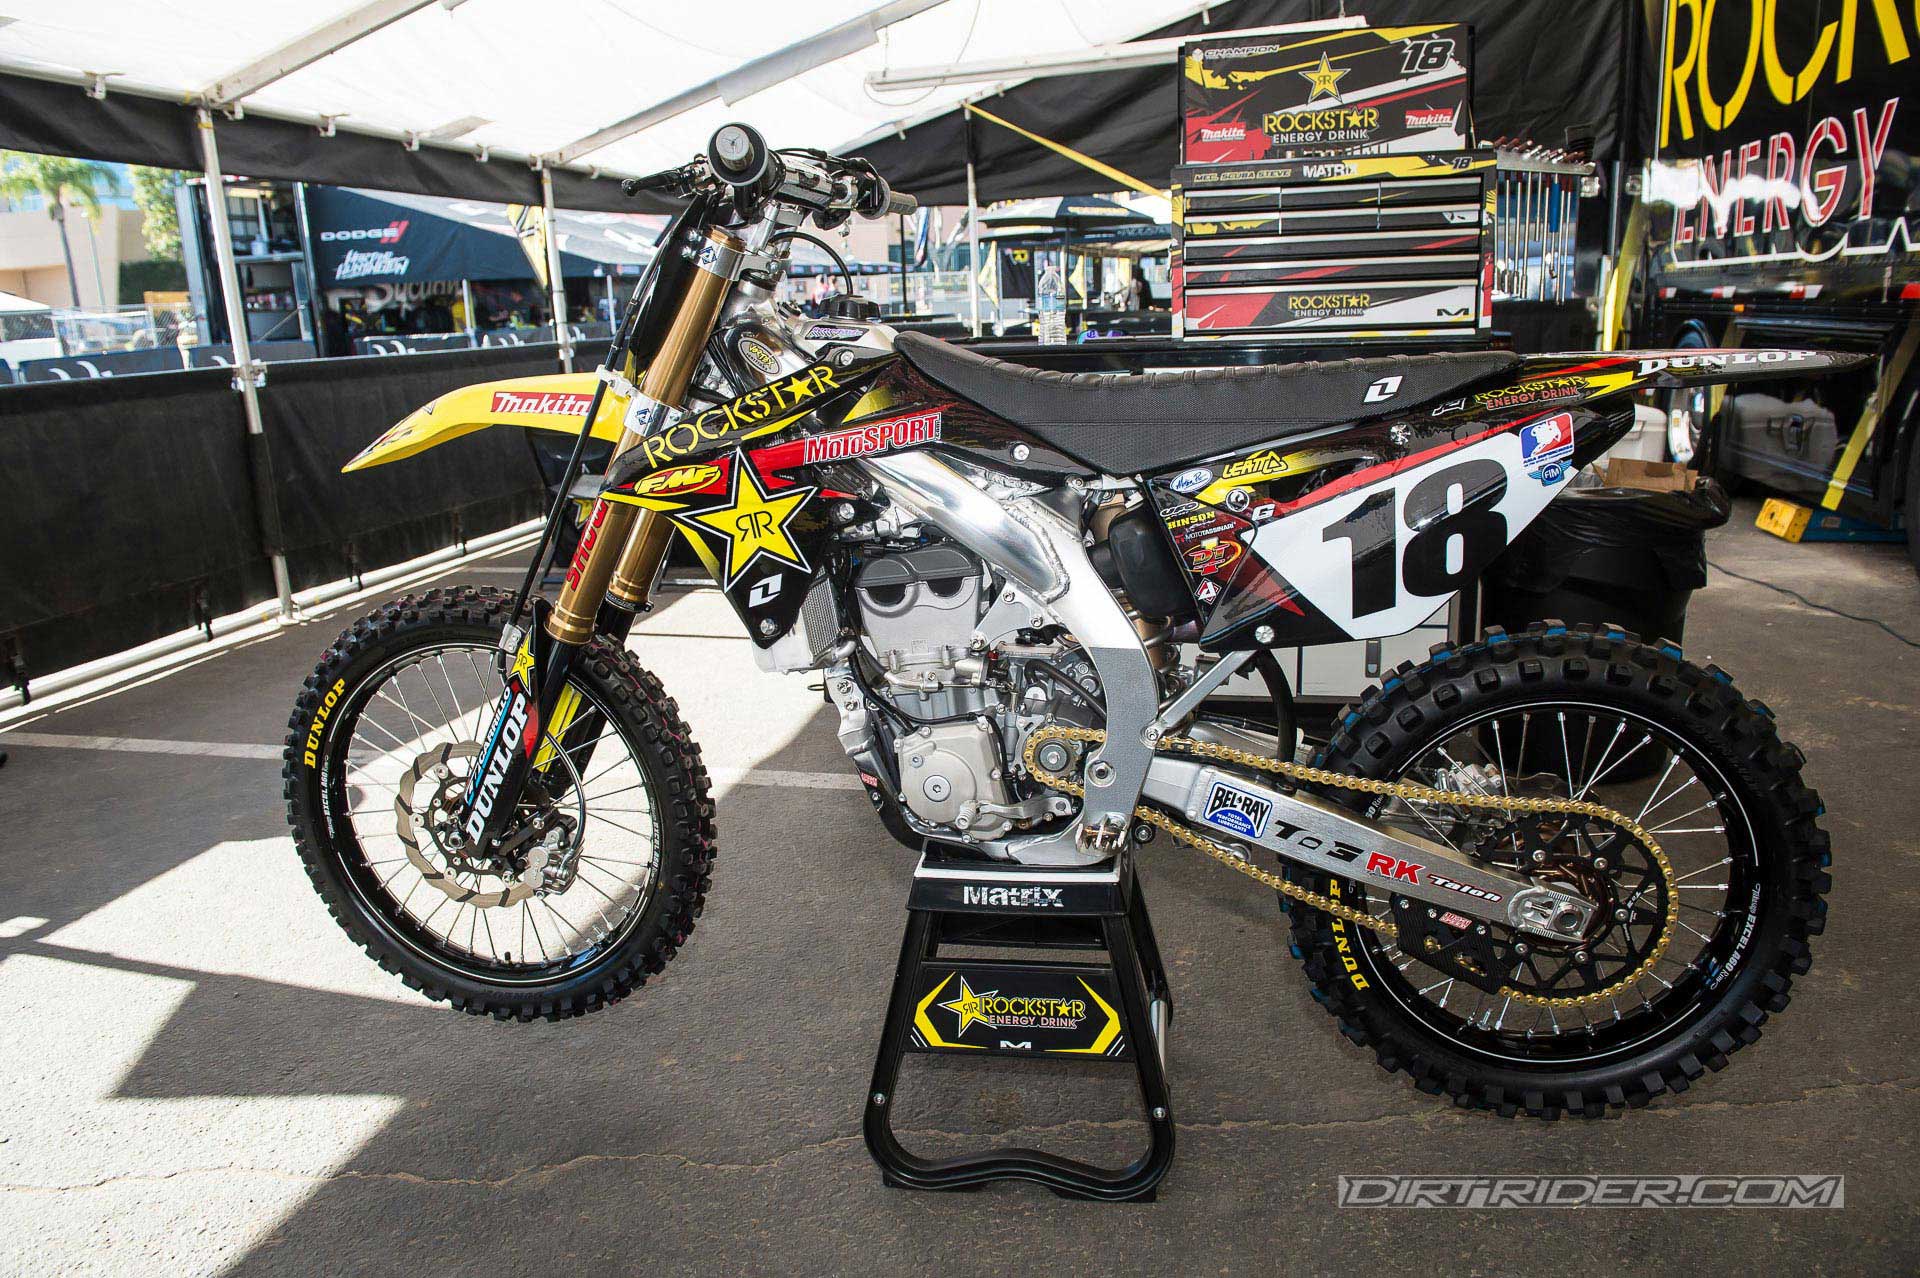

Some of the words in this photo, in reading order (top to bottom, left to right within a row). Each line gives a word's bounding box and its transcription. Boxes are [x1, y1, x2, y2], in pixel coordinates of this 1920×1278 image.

[1204, 44, 1280, 58] CHAMPION
[1401, 39, 1456, 74] 18
[1273, 131, 1322, 144] ENERGY
[1328, 129, 1368, 141] DRINK
[1303, 163, 1358, 179] MATRIX
[1452, 156, 1473, 169] 18
[320, 227, 399, 242] DODGE
[1294, 308, 1331, 318] ENERGY
[1333, 307, 1364, 317] DRINK
[1637, 351, 1816, 376] DUNLOP
[1487, 392, 1536, 409] ENERGY
[1542, 385, 1579, 399] DRINK
[636, 465, 720, 495] FMF
[1544, 468, 1560, 479] FIM
[1167, 511, 1216, 530] HINSON
[1322, 458, 1508, 619] 18
[303, 678, 346, 769] DUNLOP
[479, 685, 511, 763] CARRILLO
[465, 692, 528, 846] DUNLOP
[1366, 850, 1426, 885] RK
[963, 885, 1065, 908] Matrix
[1428, 874, 1502, 902] Talon
[1330, 879, 1371, 991] DUNLP
[1736, 913, 1757, 950] EXCEL
[1725, 950, 1742, 972] A60
[989, 1014, 1036, 1025] ENERGY
[1041, 1016, 1077, 1028] DRINK
